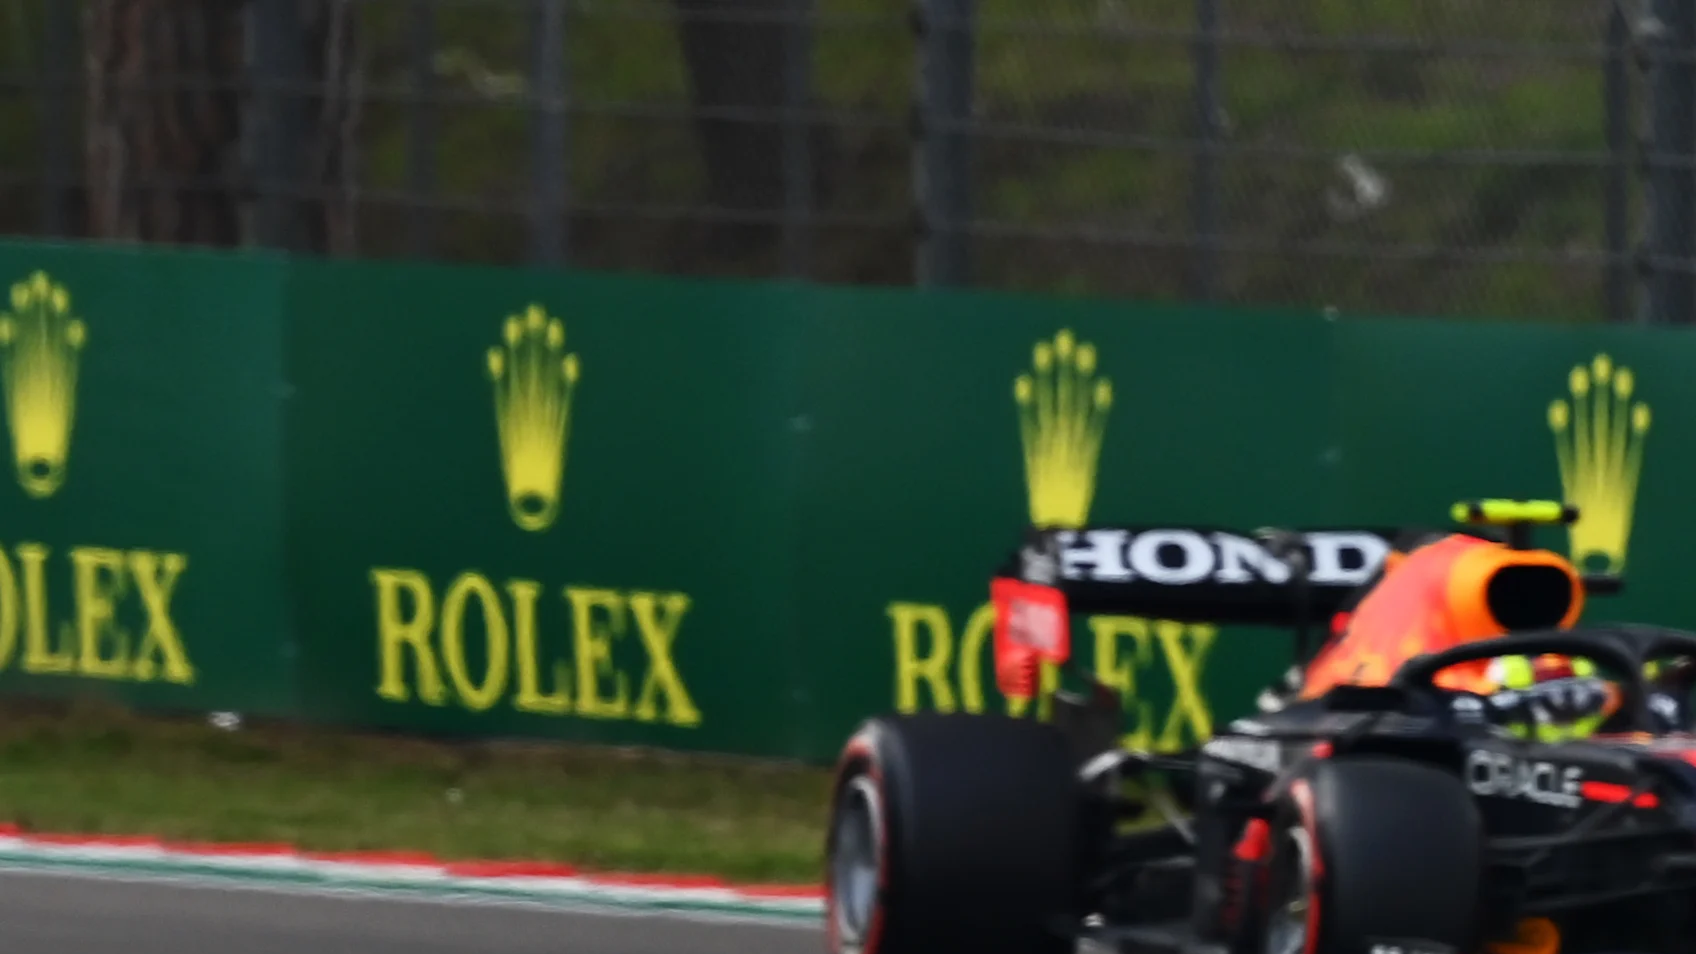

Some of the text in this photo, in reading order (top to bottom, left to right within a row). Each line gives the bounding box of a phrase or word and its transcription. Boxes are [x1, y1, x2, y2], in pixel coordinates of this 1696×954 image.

[0, 543, 194, 684] LEX
[1057, 529, 1386, 585] HOND
[370, 567, 700, 725] ROLEX
[887, 601, 1217, 754] REX
[1467, 750, 1582, 808] ORACLE
